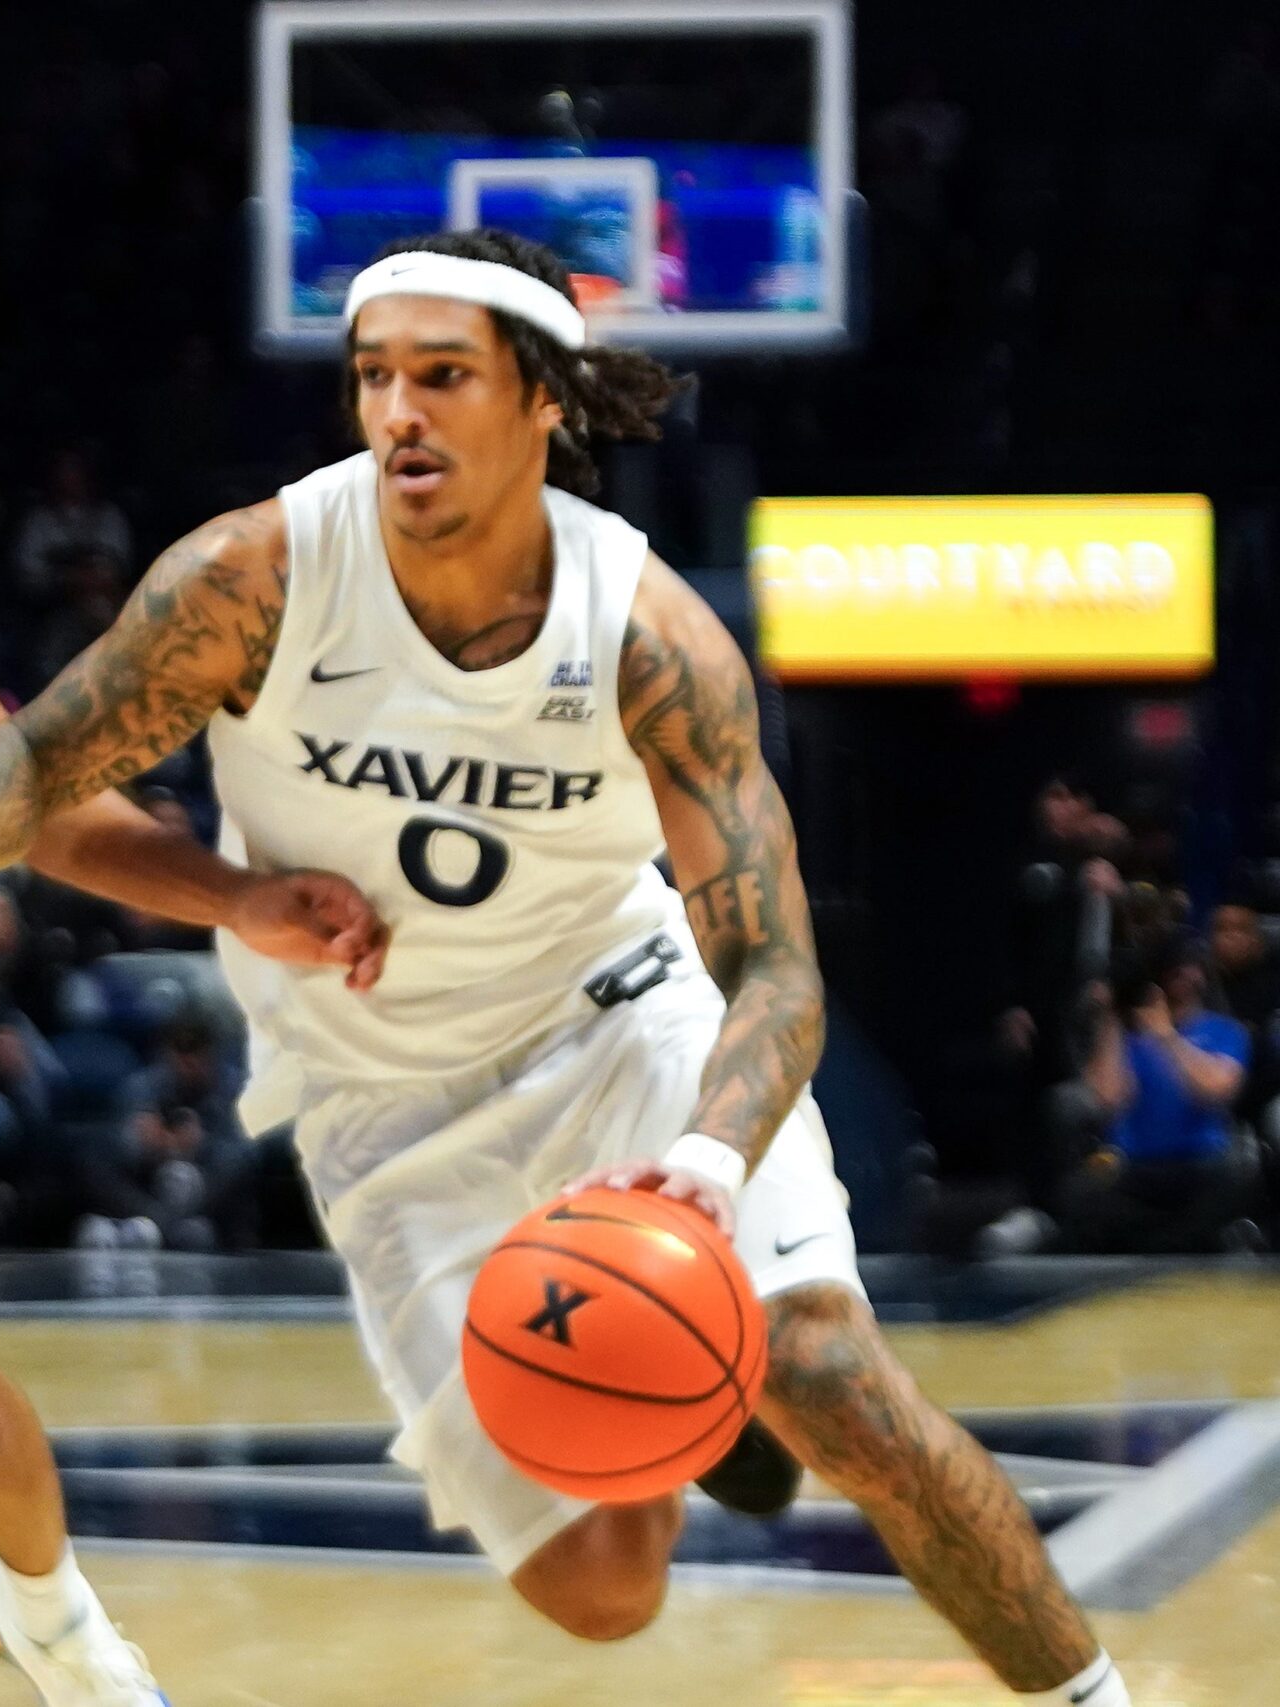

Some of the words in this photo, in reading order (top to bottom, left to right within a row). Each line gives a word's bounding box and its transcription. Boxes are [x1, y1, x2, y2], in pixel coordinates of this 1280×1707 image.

[293, 731, 604, 811] XAVIER
[398, 814, 516, 907] 0
[518, 1278, 601, 1351] X
